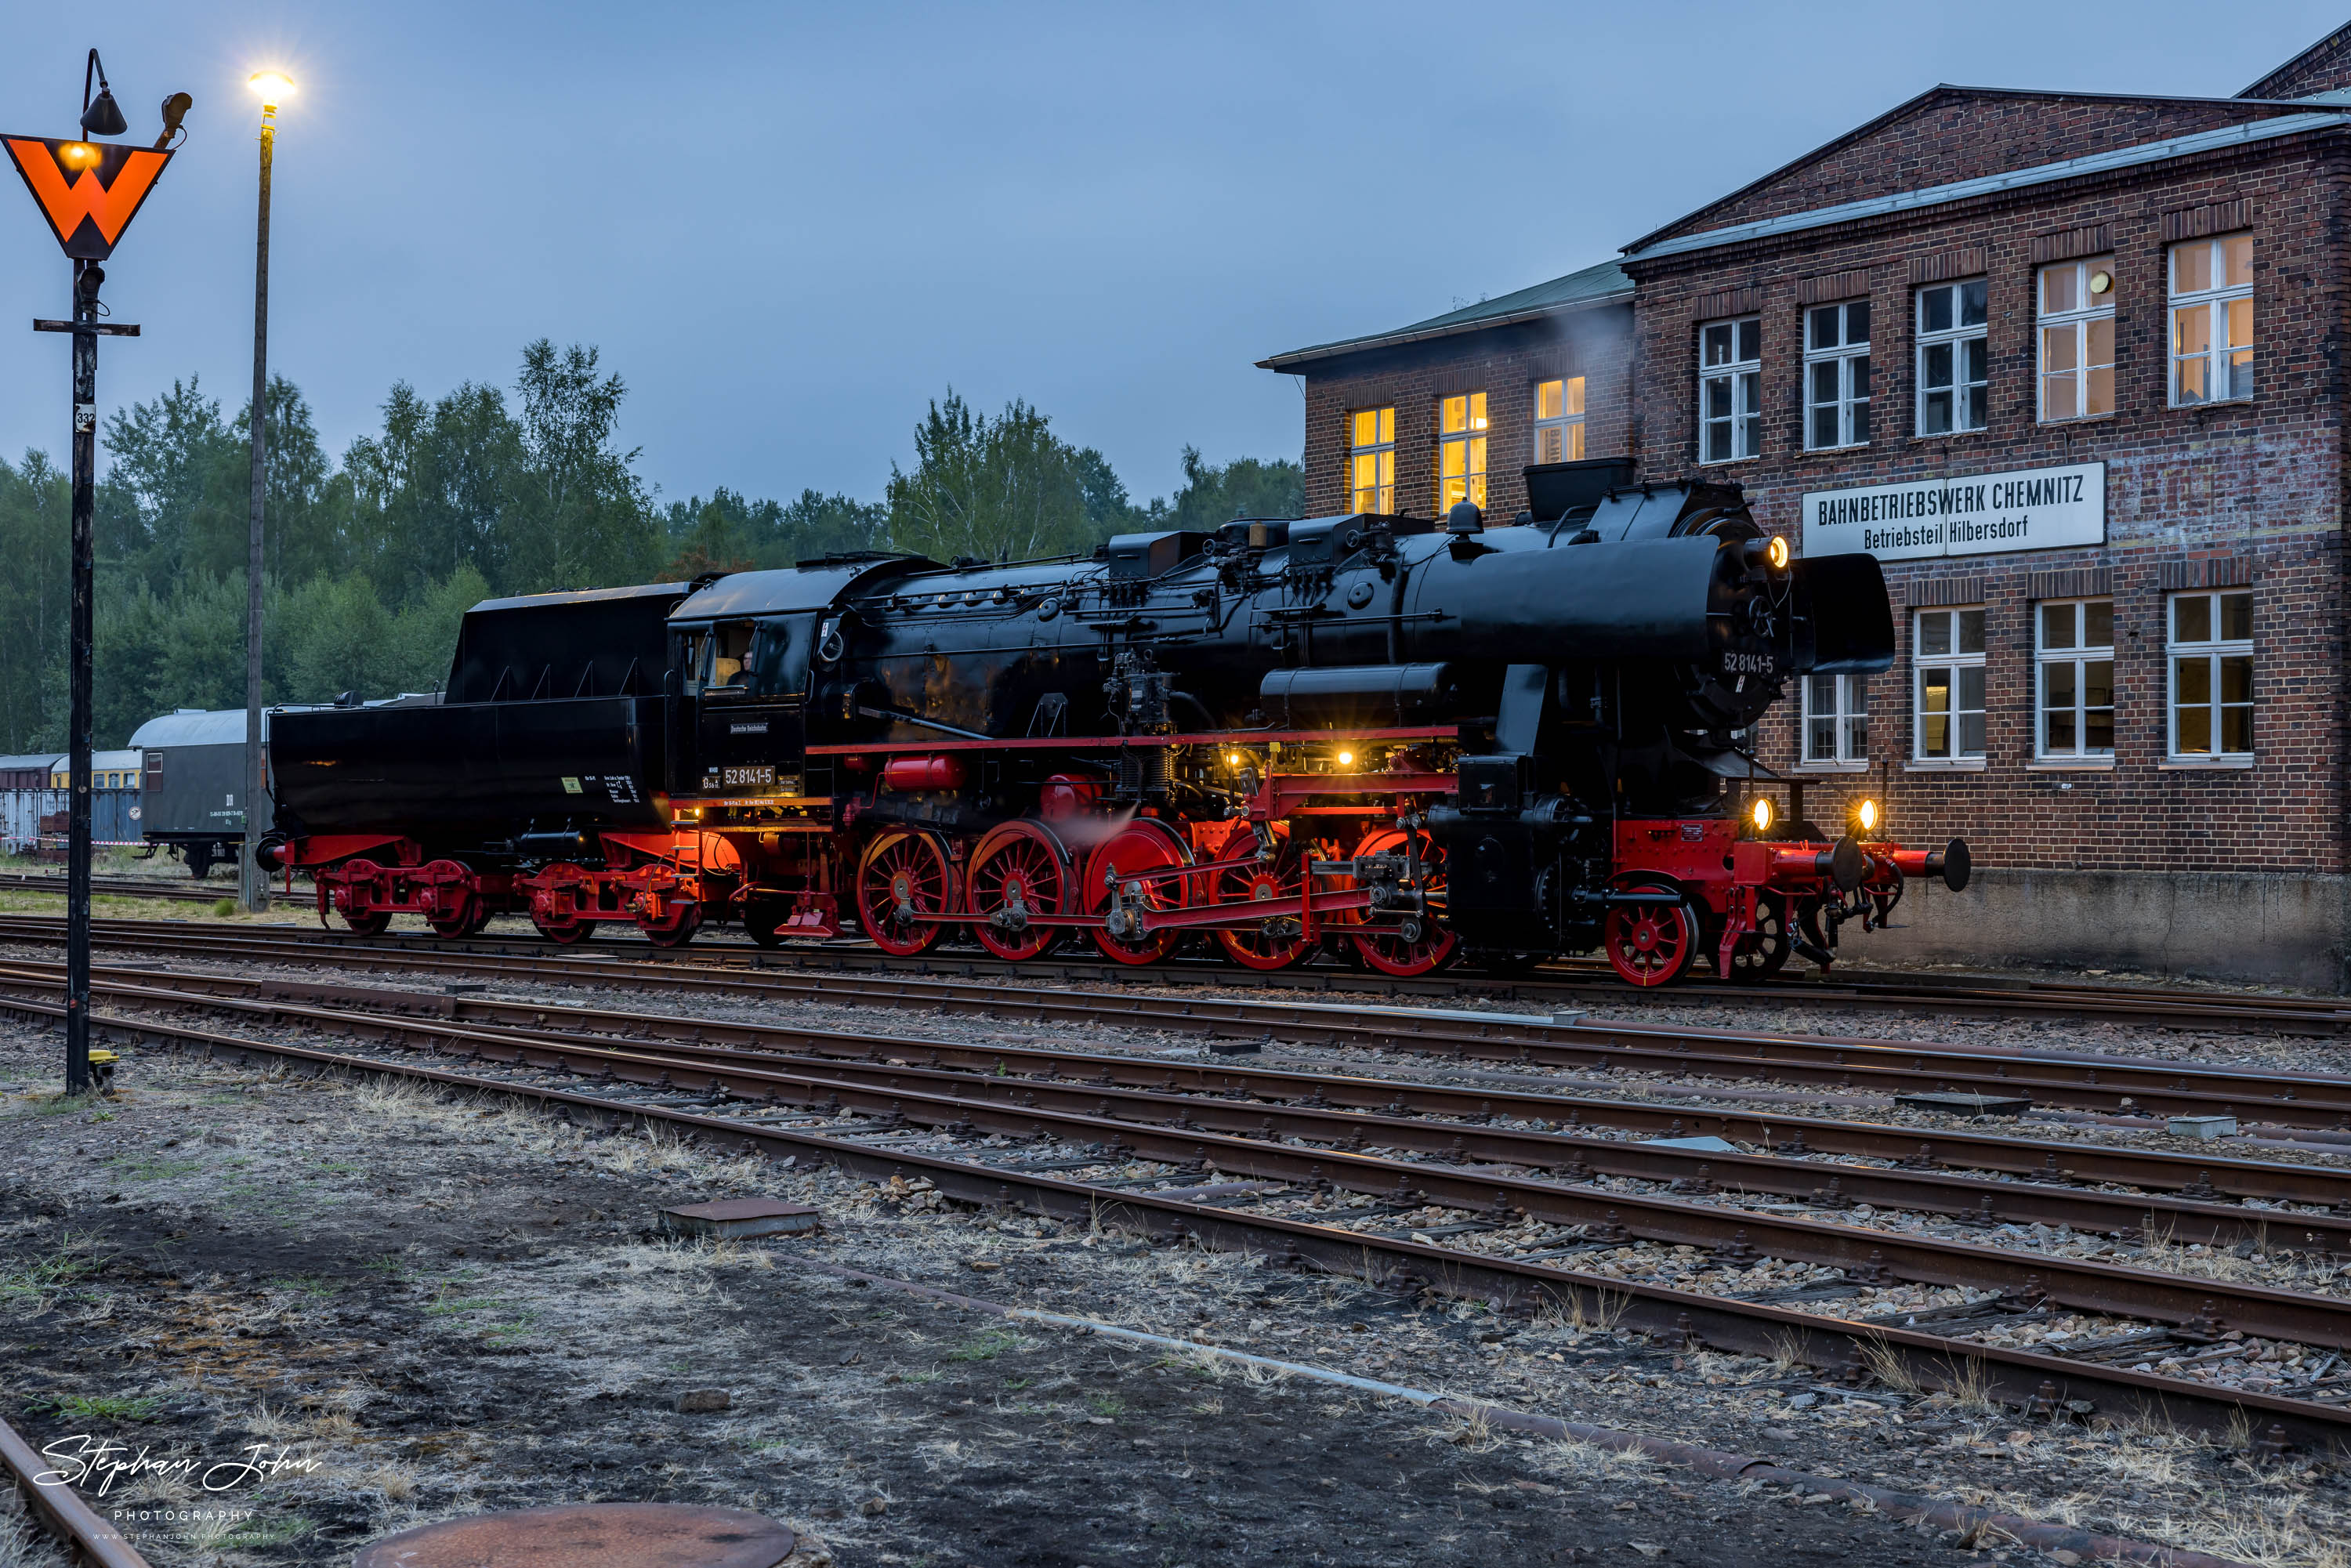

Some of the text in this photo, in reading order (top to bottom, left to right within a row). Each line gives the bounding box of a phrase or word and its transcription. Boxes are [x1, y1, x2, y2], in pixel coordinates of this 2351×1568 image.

[8, 139, 168, 246] W
[77, 412, 95, 424] 332
[1818, 474, 2084, 526] BAHNBETRIEBSWERK CHEMNITZ
[1864, 516, 2028, 549] Betriebsteil Hilbersdorf
[1724, 652, 1773, 674] 52 8141-5
[725, 770, 737, 784] 52
[739, 769, 772, 784] 8141-5
